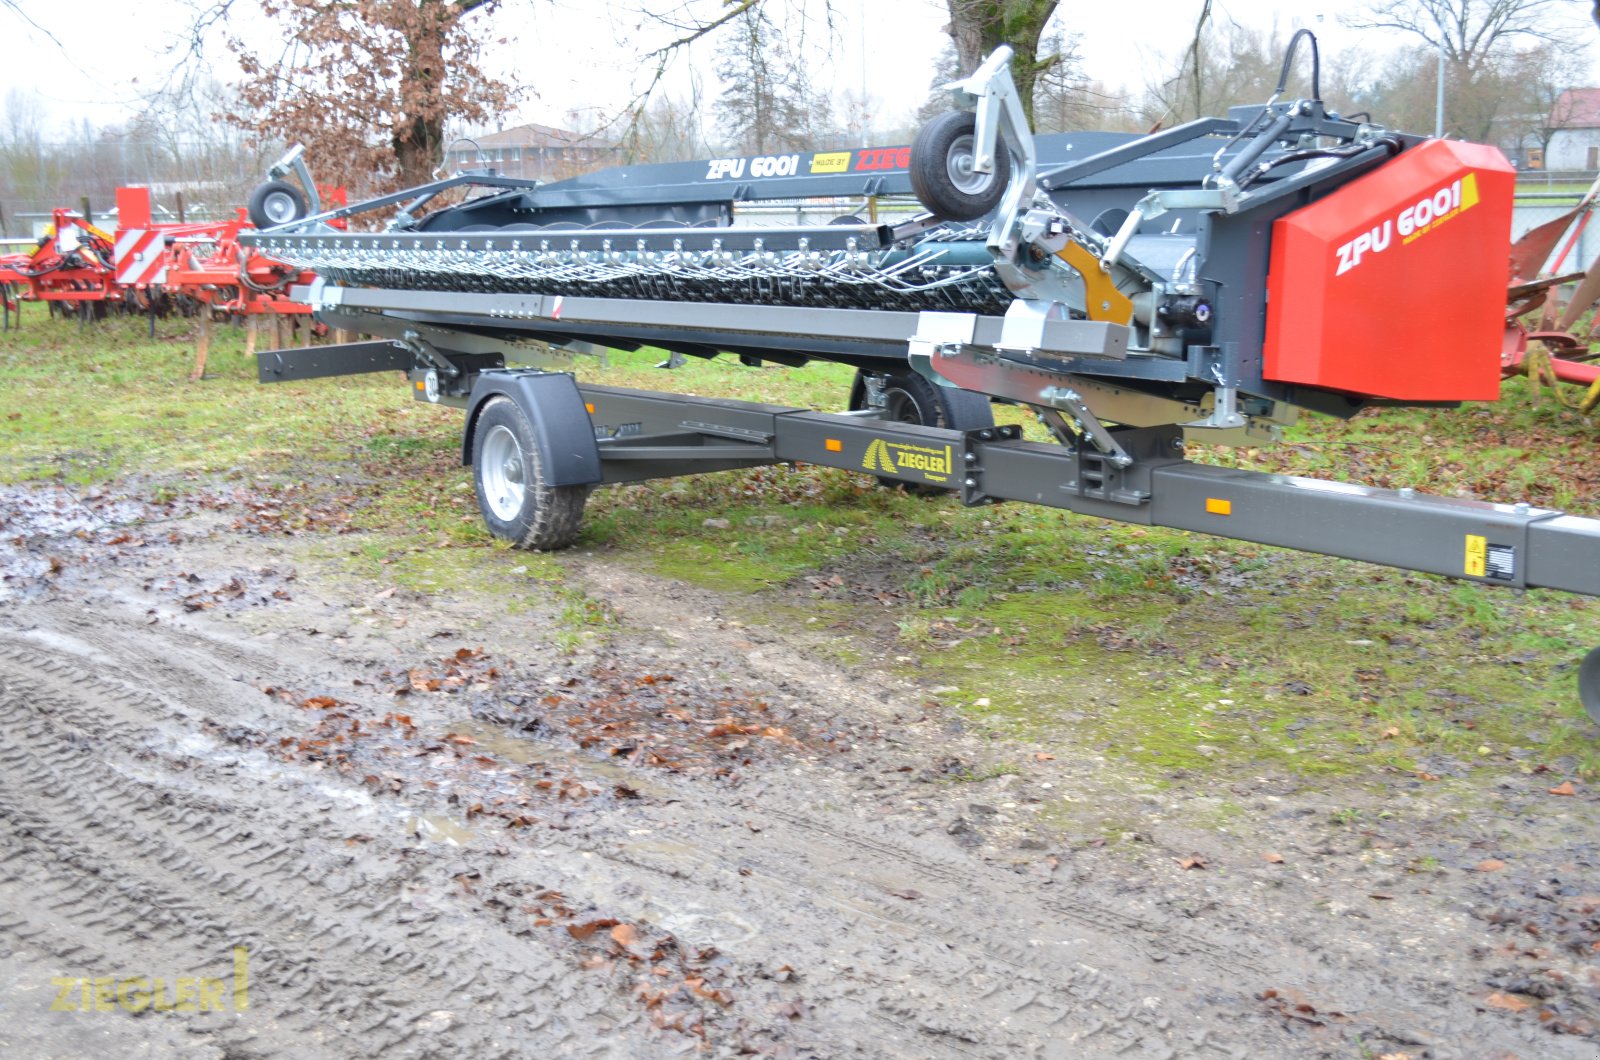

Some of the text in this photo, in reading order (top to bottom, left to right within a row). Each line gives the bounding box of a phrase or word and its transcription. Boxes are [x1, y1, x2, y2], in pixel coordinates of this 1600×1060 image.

[705, 154, 799, 180] ZPU 6001
[855, 147, 912, 171] ZIEG
[1335, 179, 1461, 276] ZPU 6001
[897, 451, 946, 473] ZIEGLER
